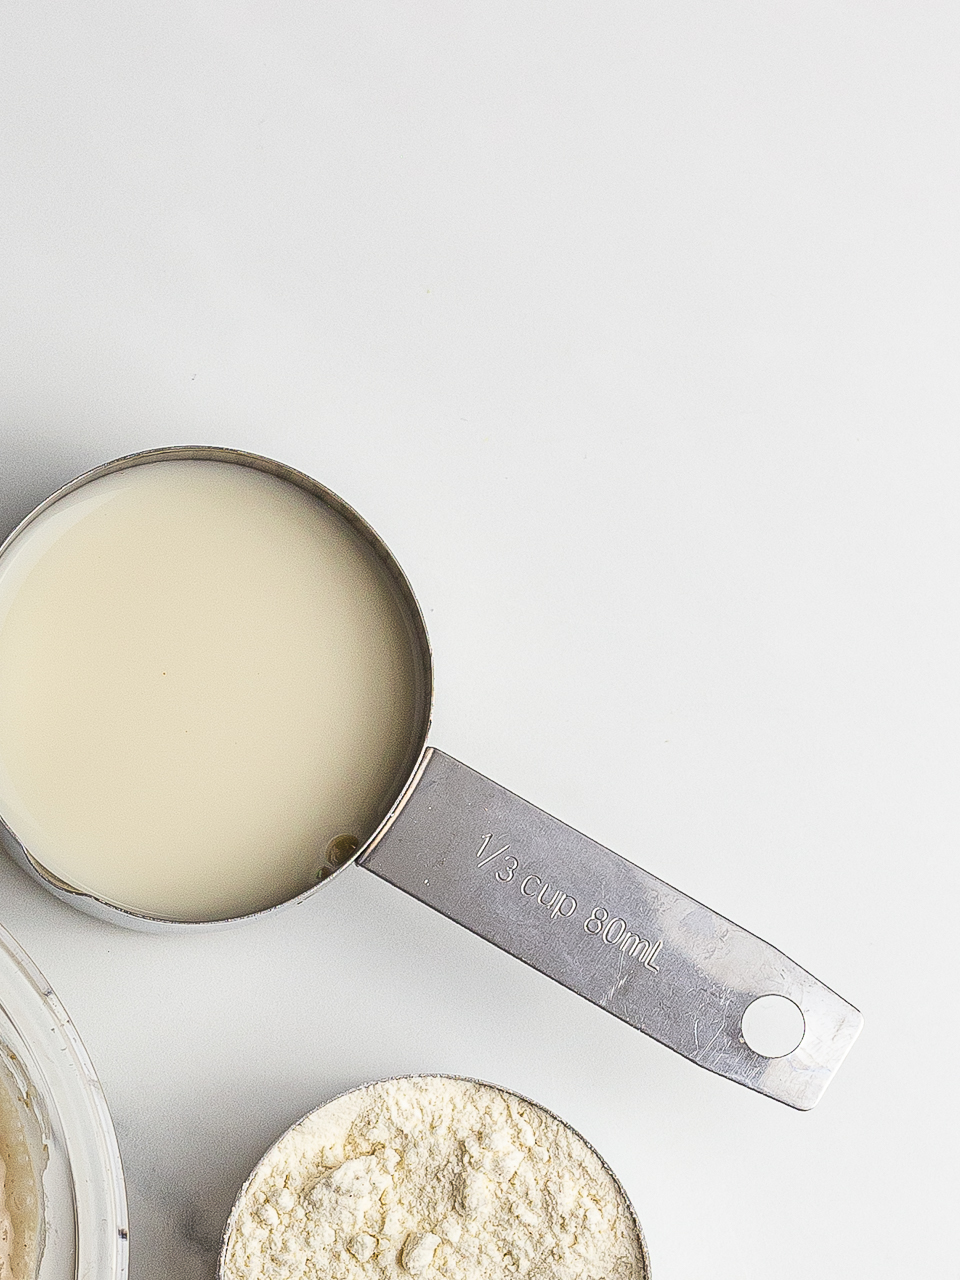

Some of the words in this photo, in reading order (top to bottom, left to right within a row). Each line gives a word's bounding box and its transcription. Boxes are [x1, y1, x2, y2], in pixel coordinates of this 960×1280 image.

[477, 833, 519, 883] 1/3
[520, 874, 578, 919] cup
[583, 906, 663, 973] 80mL
